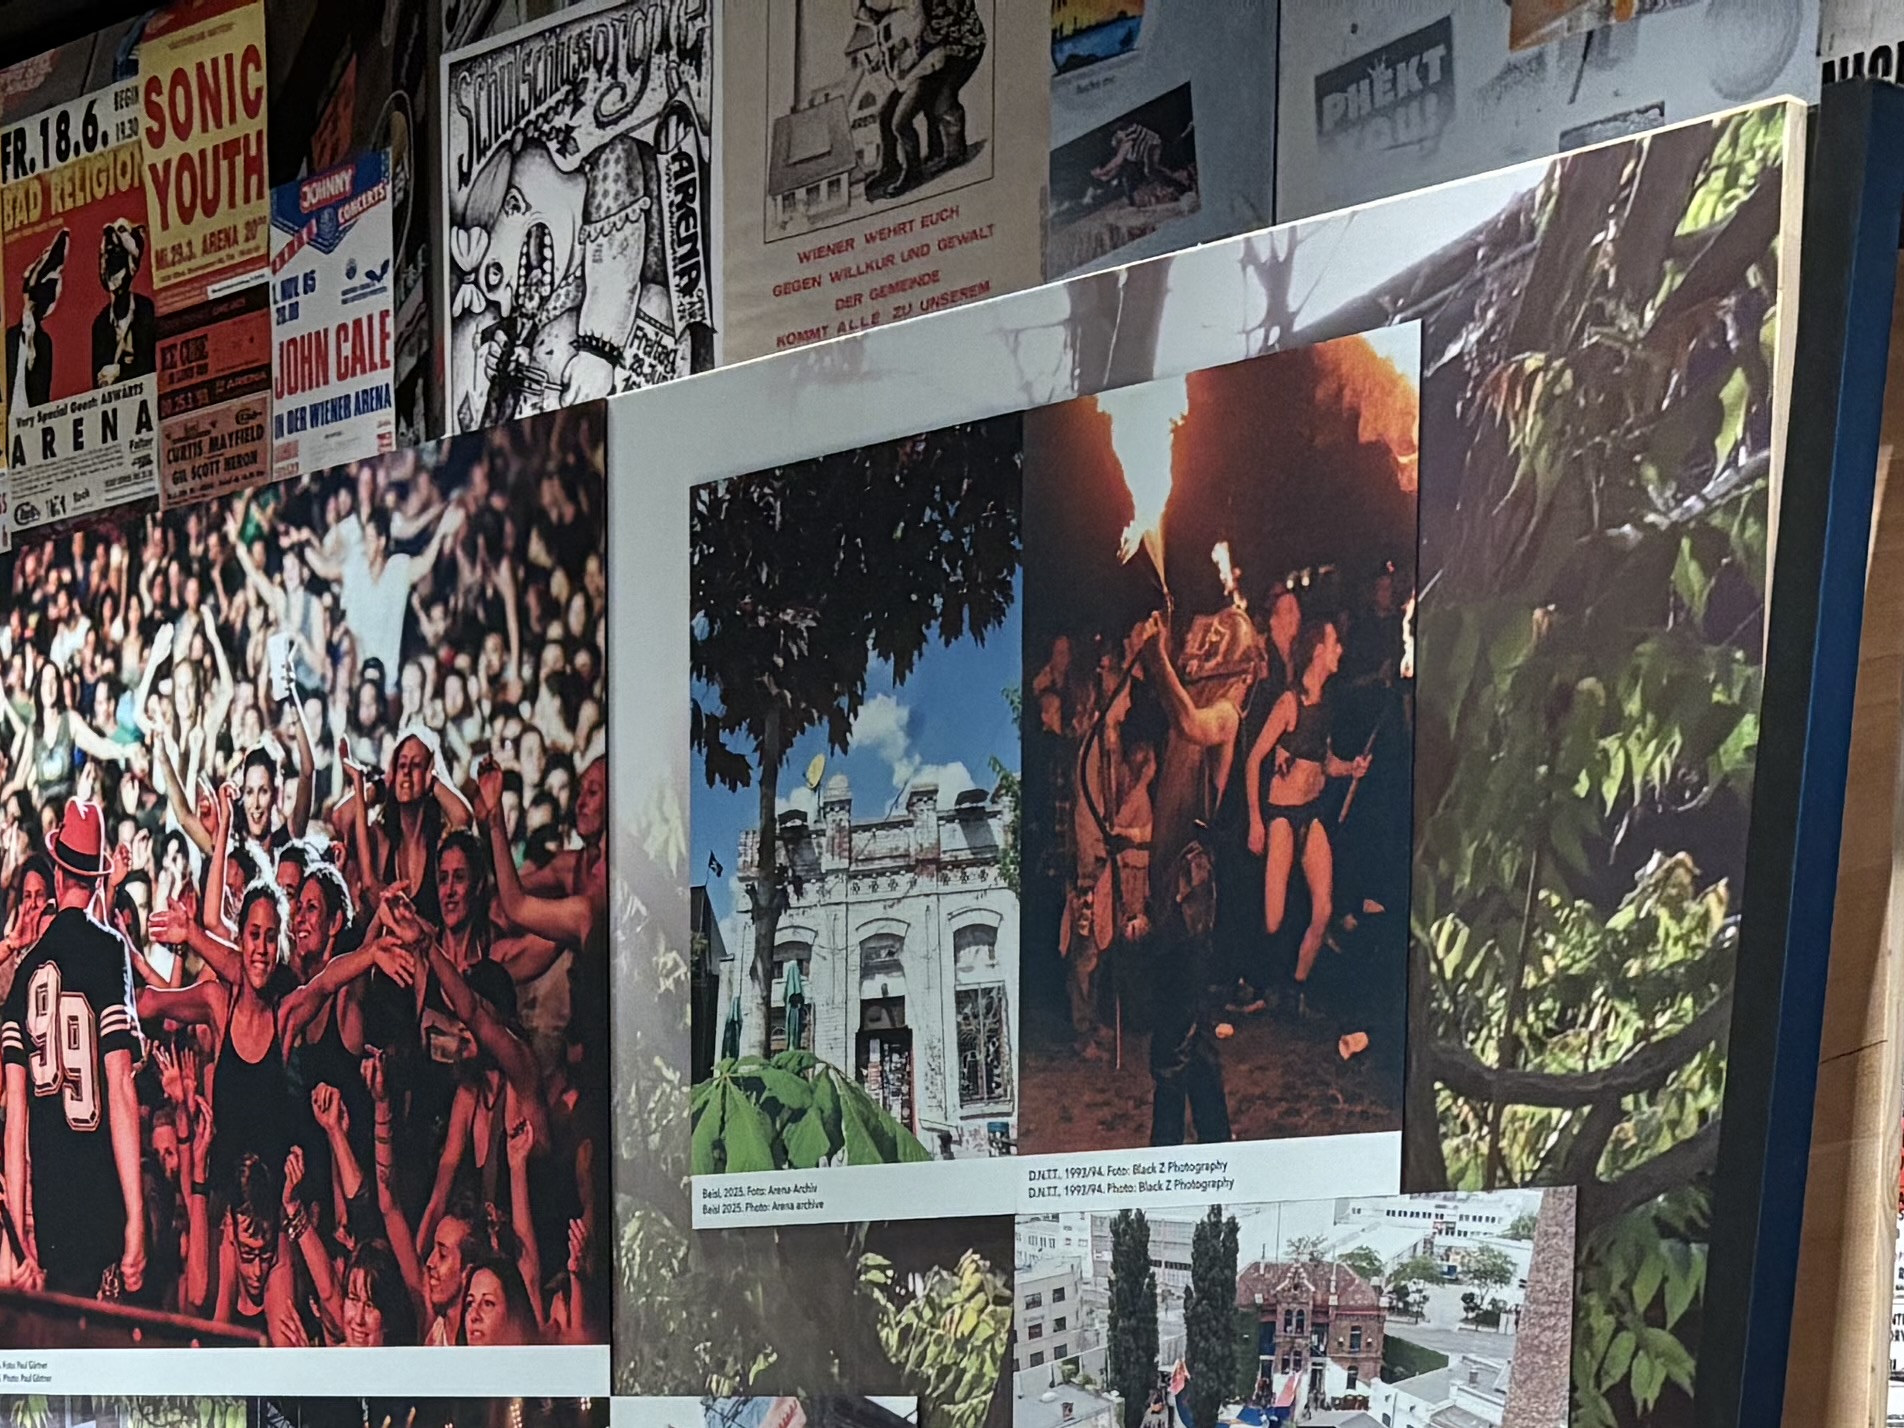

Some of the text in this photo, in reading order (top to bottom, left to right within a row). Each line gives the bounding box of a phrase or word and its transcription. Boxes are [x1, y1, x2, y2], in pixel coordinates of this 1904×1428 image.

[143, 43, 264, 149] SONIC
[0, 98, 109, 184] FR.18.6.
[3, 146, 144, 233] BAD RELIGION
[148, 129, 264, 231] YOUTH
[302, 168, 353, 209] JOHNNY
[772, 275, 822, 297] GEGEN
[900, 243, 931, 263] UND
[937, 223, 995, 252] GEWALT
[797, 206, 959, 264] WIENER WEHRT EUCH
[776, 325, 829, 348] KOMMT
[837, 312, 880, 334] ALLE
[892, 303, 913, 321] ZU
[835, 269, 941, 311] DER GEMEINDE
[275, 309, 391, 400] JOHN CALE
[12, 399, 153, 469] ARENA
[306, 396, 351, 429] WIENER
[354, 383, 392, 417] ARENA
[167, 424, 265, 465] CURTIS MAYFIELD
[26, 959, 99, 1131] 99
